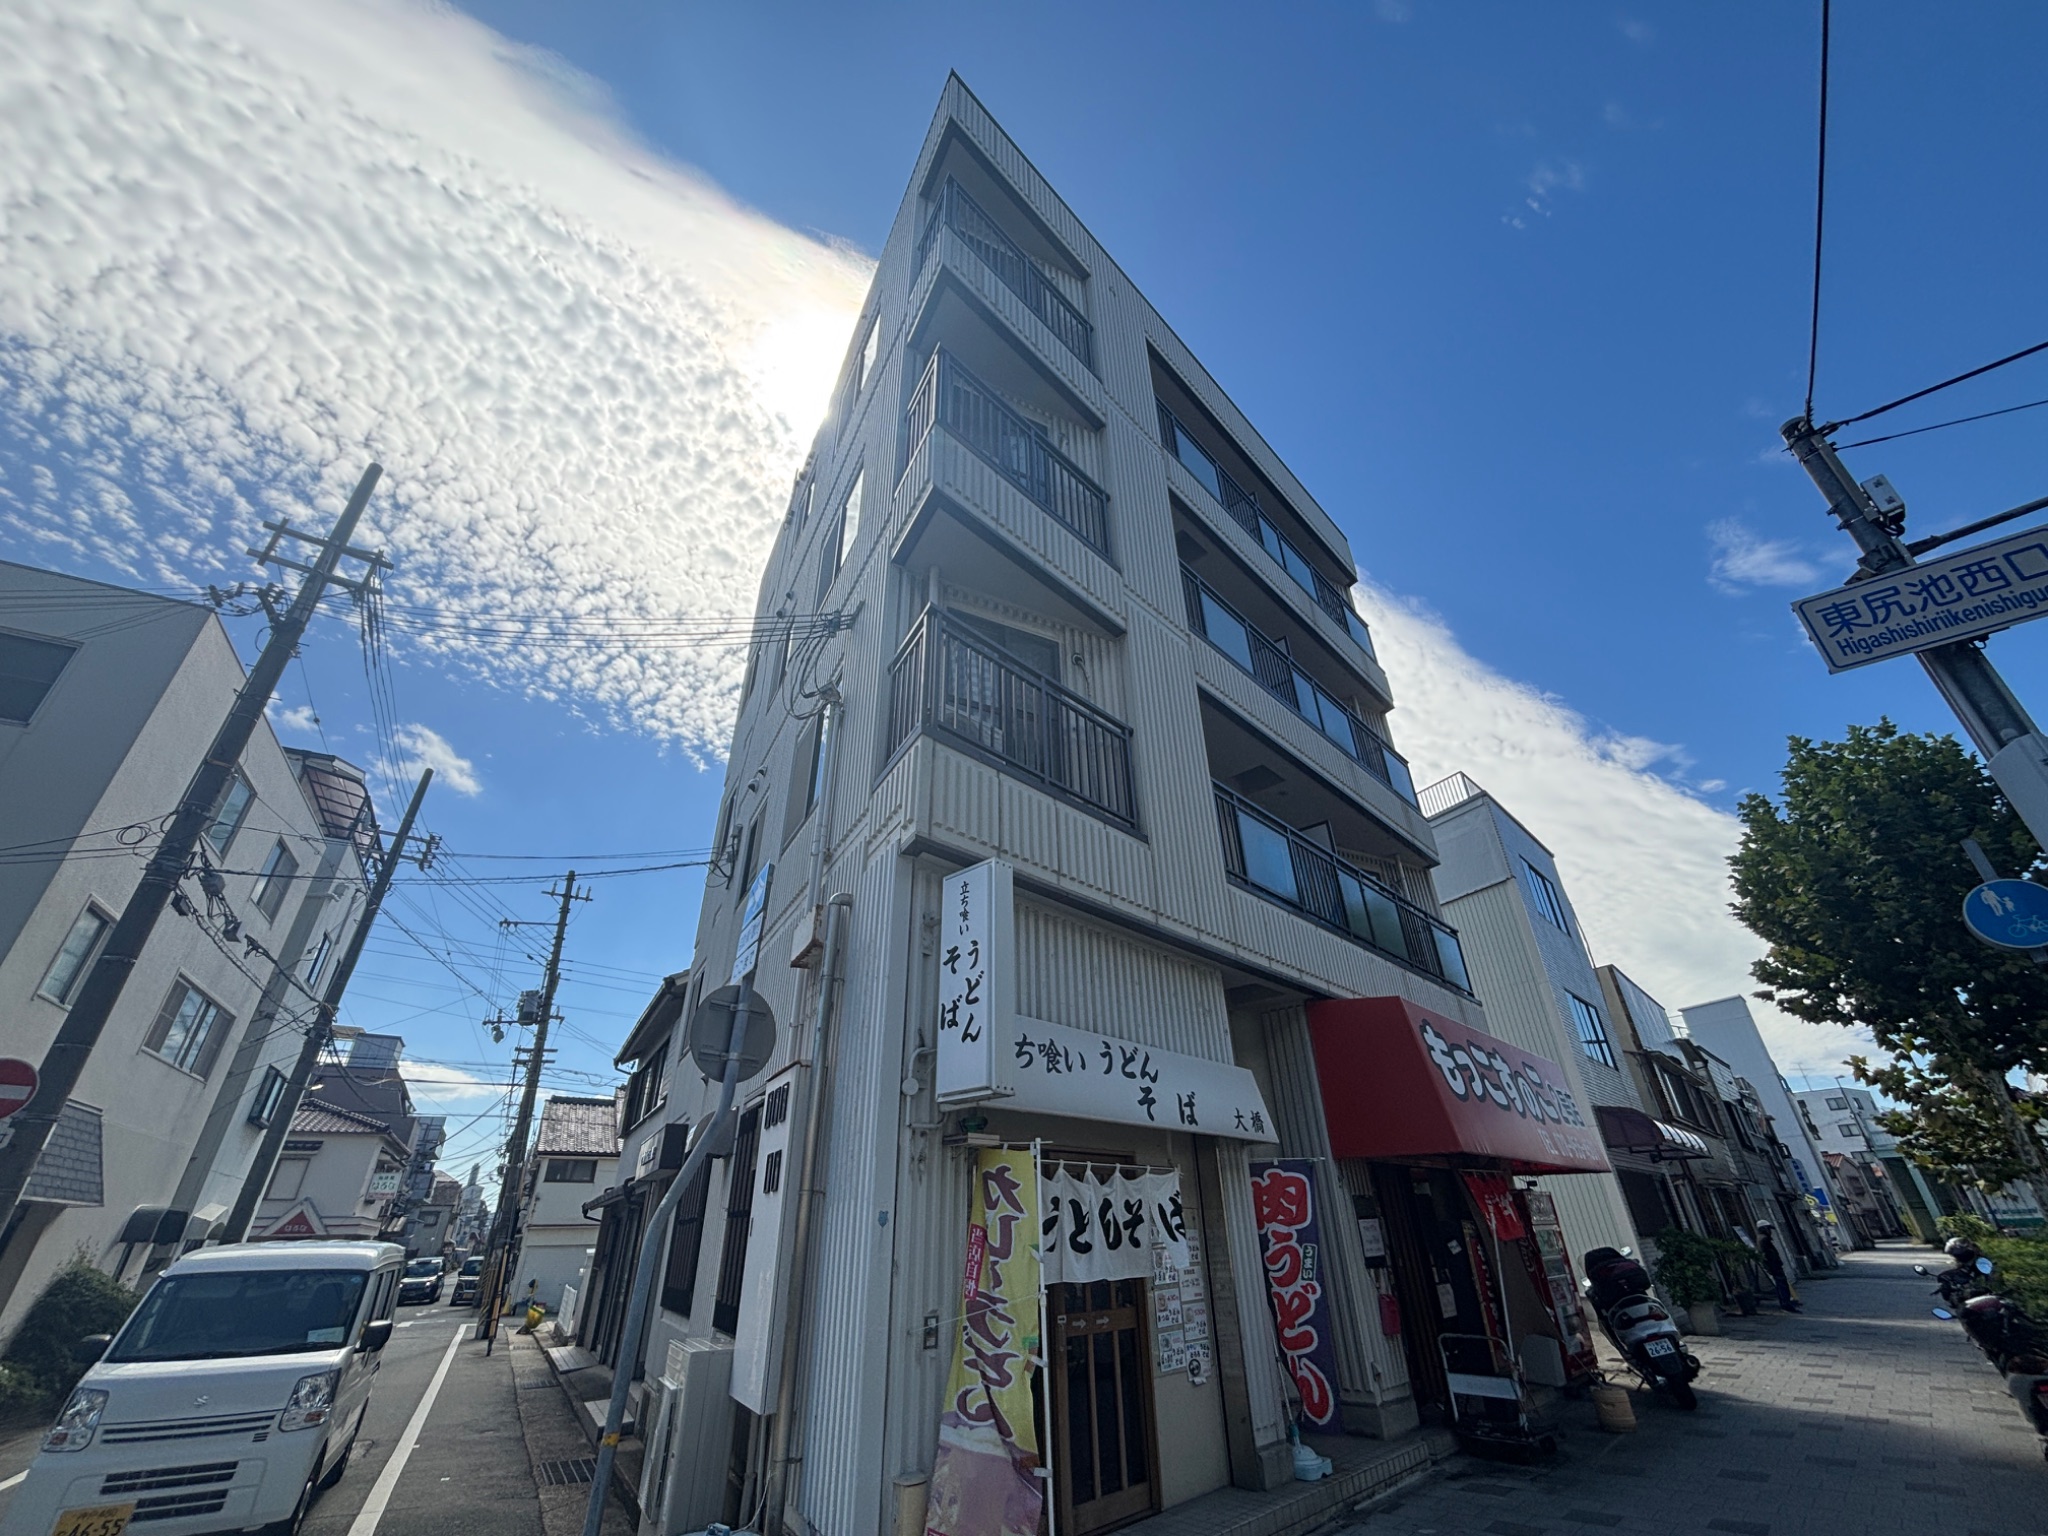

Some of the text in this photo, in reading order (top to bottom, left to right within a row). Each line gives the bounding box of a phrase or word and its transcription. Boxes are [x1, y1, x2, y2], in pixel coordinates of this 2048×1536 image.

[1814, 542, 2048, 639] 東尻池西口
[959, 880, 971, 936] 立ち喰い
[940, 945, 962, 1032] そば
[961, 939, 985, 1043] うどん
[1098, 1040, 1159, 1084] うどん
[1136, 1085, 1199, 1127] そば
[1234, 1107, 1266, 1136] 大橋
[1251, 1169, 1333, 1424] 肉うどん
[1648, 1343, 1673, 1356] 26-56
